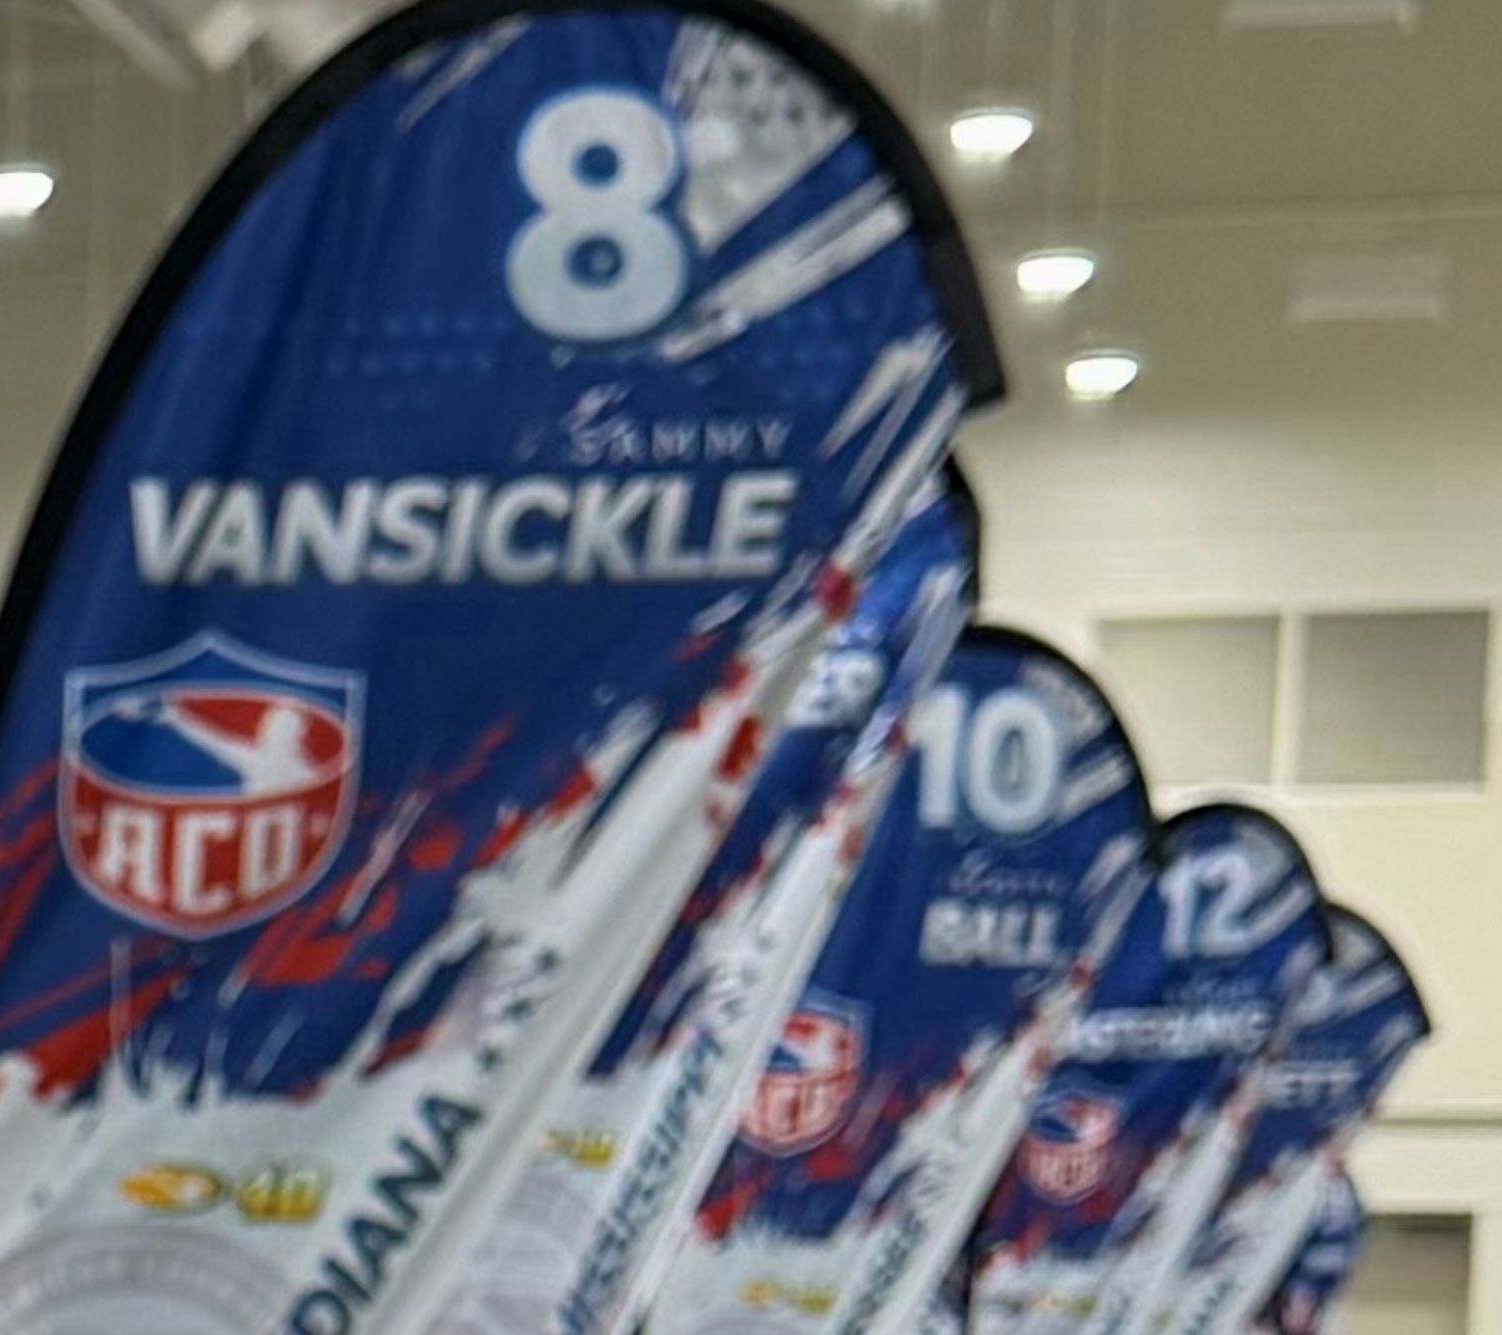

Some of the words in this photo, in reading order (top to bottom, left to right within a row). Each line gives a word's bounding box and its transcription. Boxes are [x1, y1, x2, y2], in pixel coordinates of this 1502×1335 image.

[505, 84, 688, 343] 8
[567, 417, 793, 465] SAMMY
[128, 470, 799, 586] VANSICKLE
[904, 683, 1061, 834] 10
[98, 803, 302, 915] ACO
[1157, 847, 1255, 958] 12
[919, 901, 1060, 967] BALL
